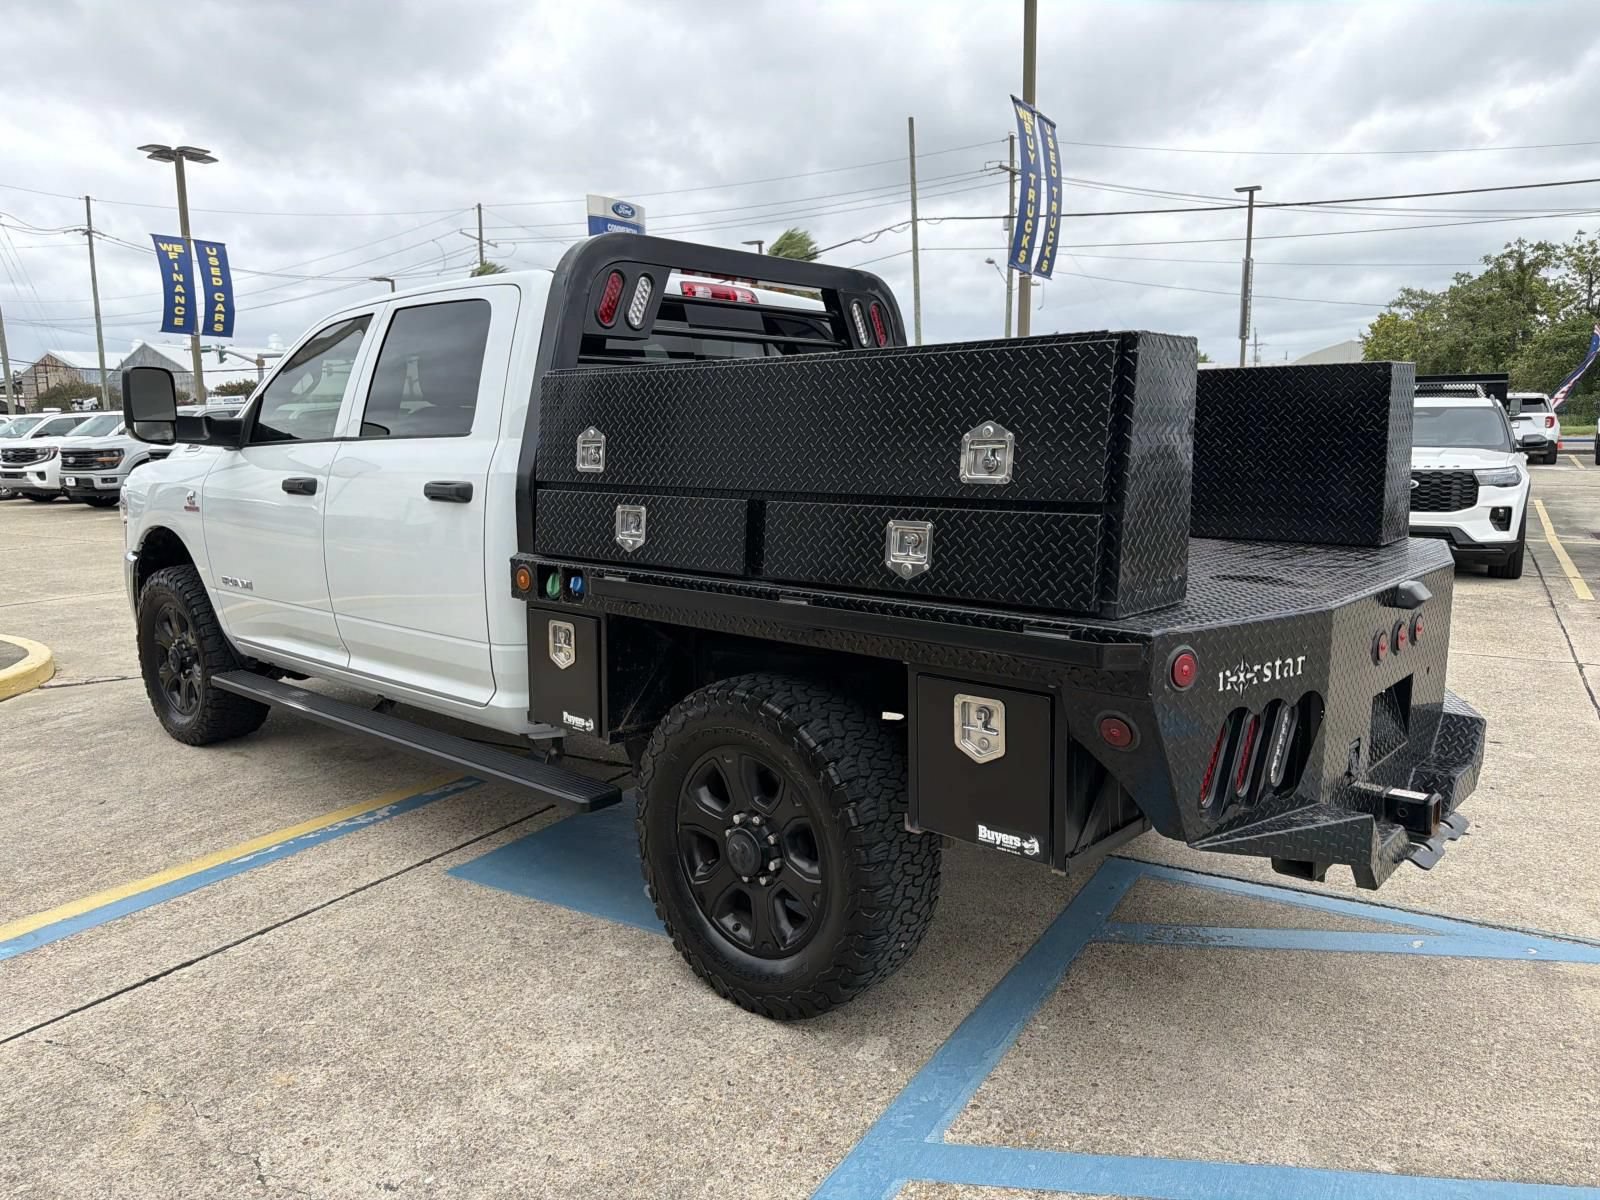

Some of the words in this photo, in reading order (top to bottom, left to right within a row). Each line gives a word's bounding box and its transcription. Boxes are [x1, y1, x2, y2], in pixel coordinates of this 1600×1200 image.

[1016, 104, 1034, 126] WE
[1024, 120, 1035, 165] BUY
[1044, 122, 1057, 178] USED
[1018, 173, 1036, 264] TRUCKS
[1041, 186, 1058, 272] TRUCKS
[159, 242, 184, 253] WE
[205, 246, 223, 286] USED
[168, 252, 185, 326] FINANCE
[213, 292, 225, 332] CARS
[977, 824, 1021, 847] Buyers
